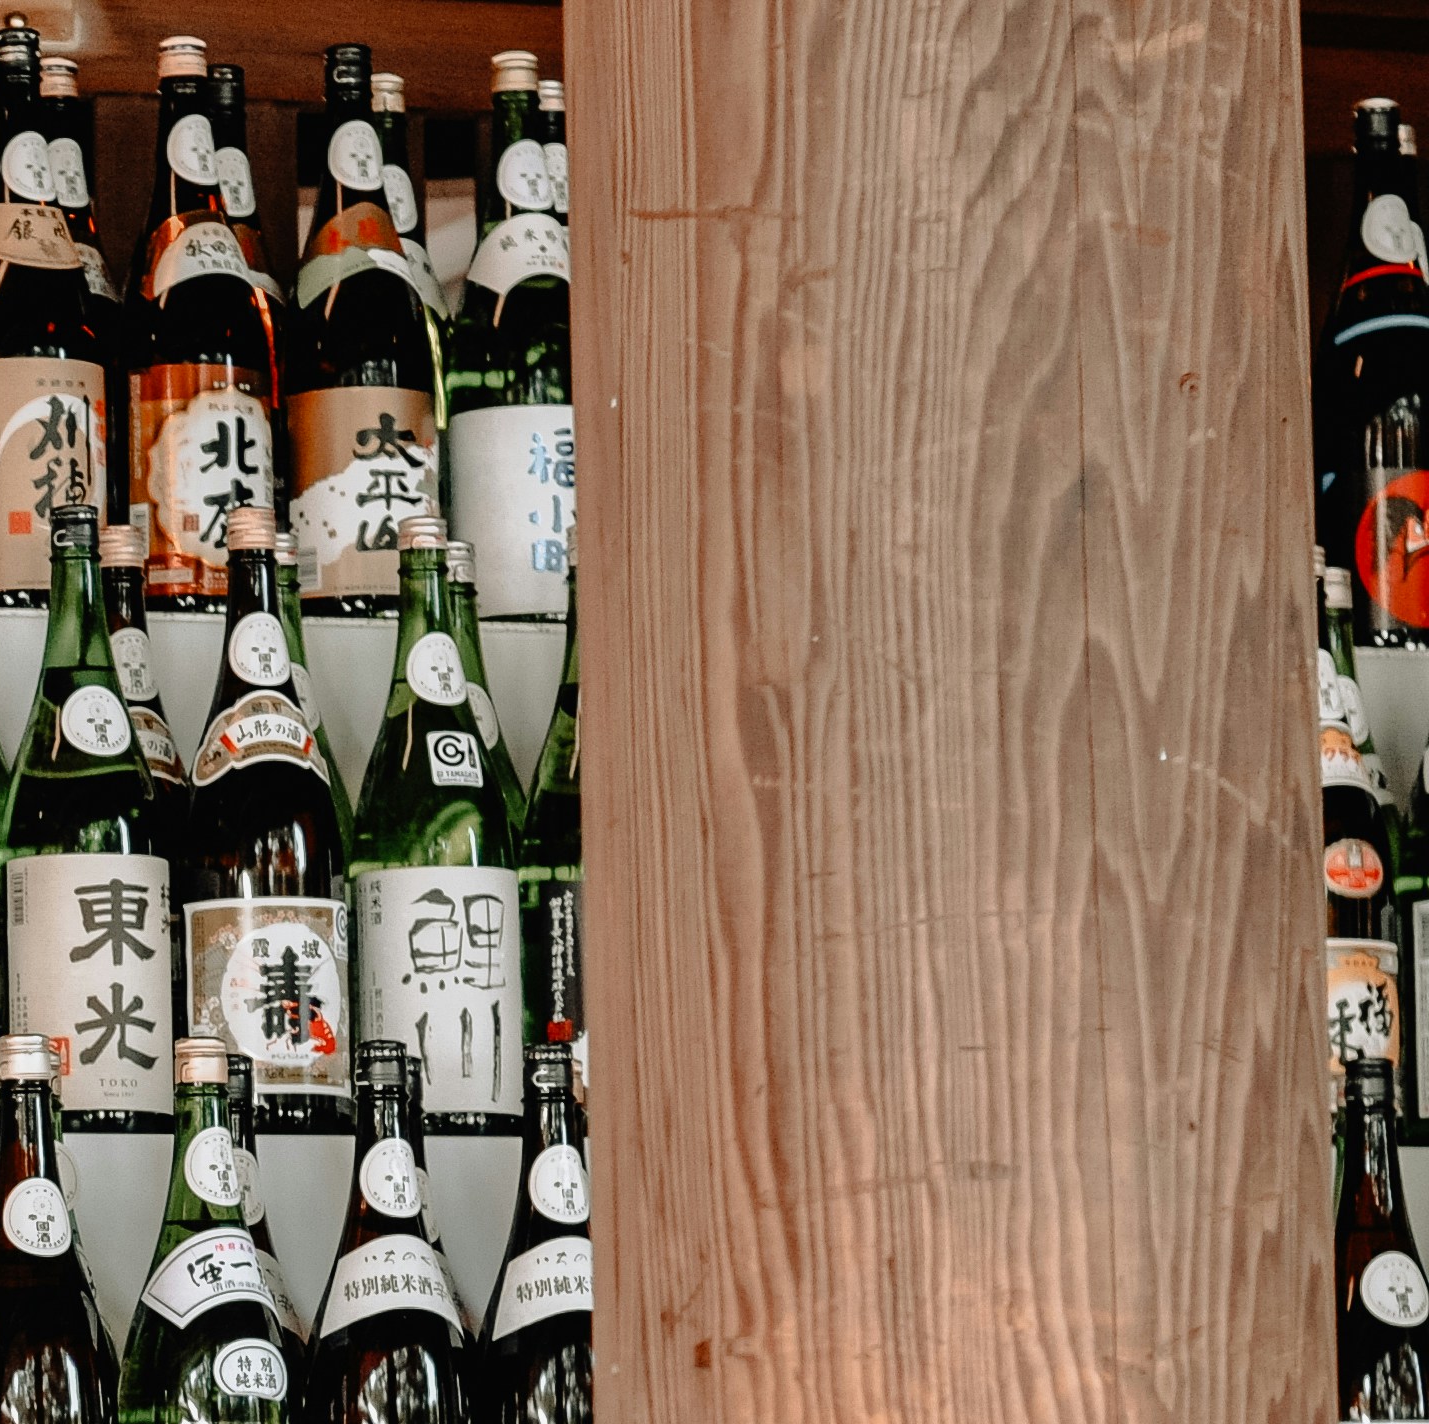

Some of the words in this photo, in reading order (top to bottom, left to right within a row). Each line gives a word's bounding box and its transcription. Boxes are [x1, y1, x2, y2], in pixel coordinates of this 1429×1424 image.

[353, 413, 420, 552] 太平山
[237, 716, 302, 746] 山形の酒
[251, 936, 323, 960] 霞城
[68, 878, 159, 1070] 東光
[401, 886, 506, 1104] 鯉川
[99, 1078, 139, 1087] TOKO
[343, 1272, 432, 1302] 特別純米酒
[515, 1274, 594, 1305] 特別純米
[237, 1356, 273, 1373] 特別
[235, 1372, 278, 1390] 純米酒
